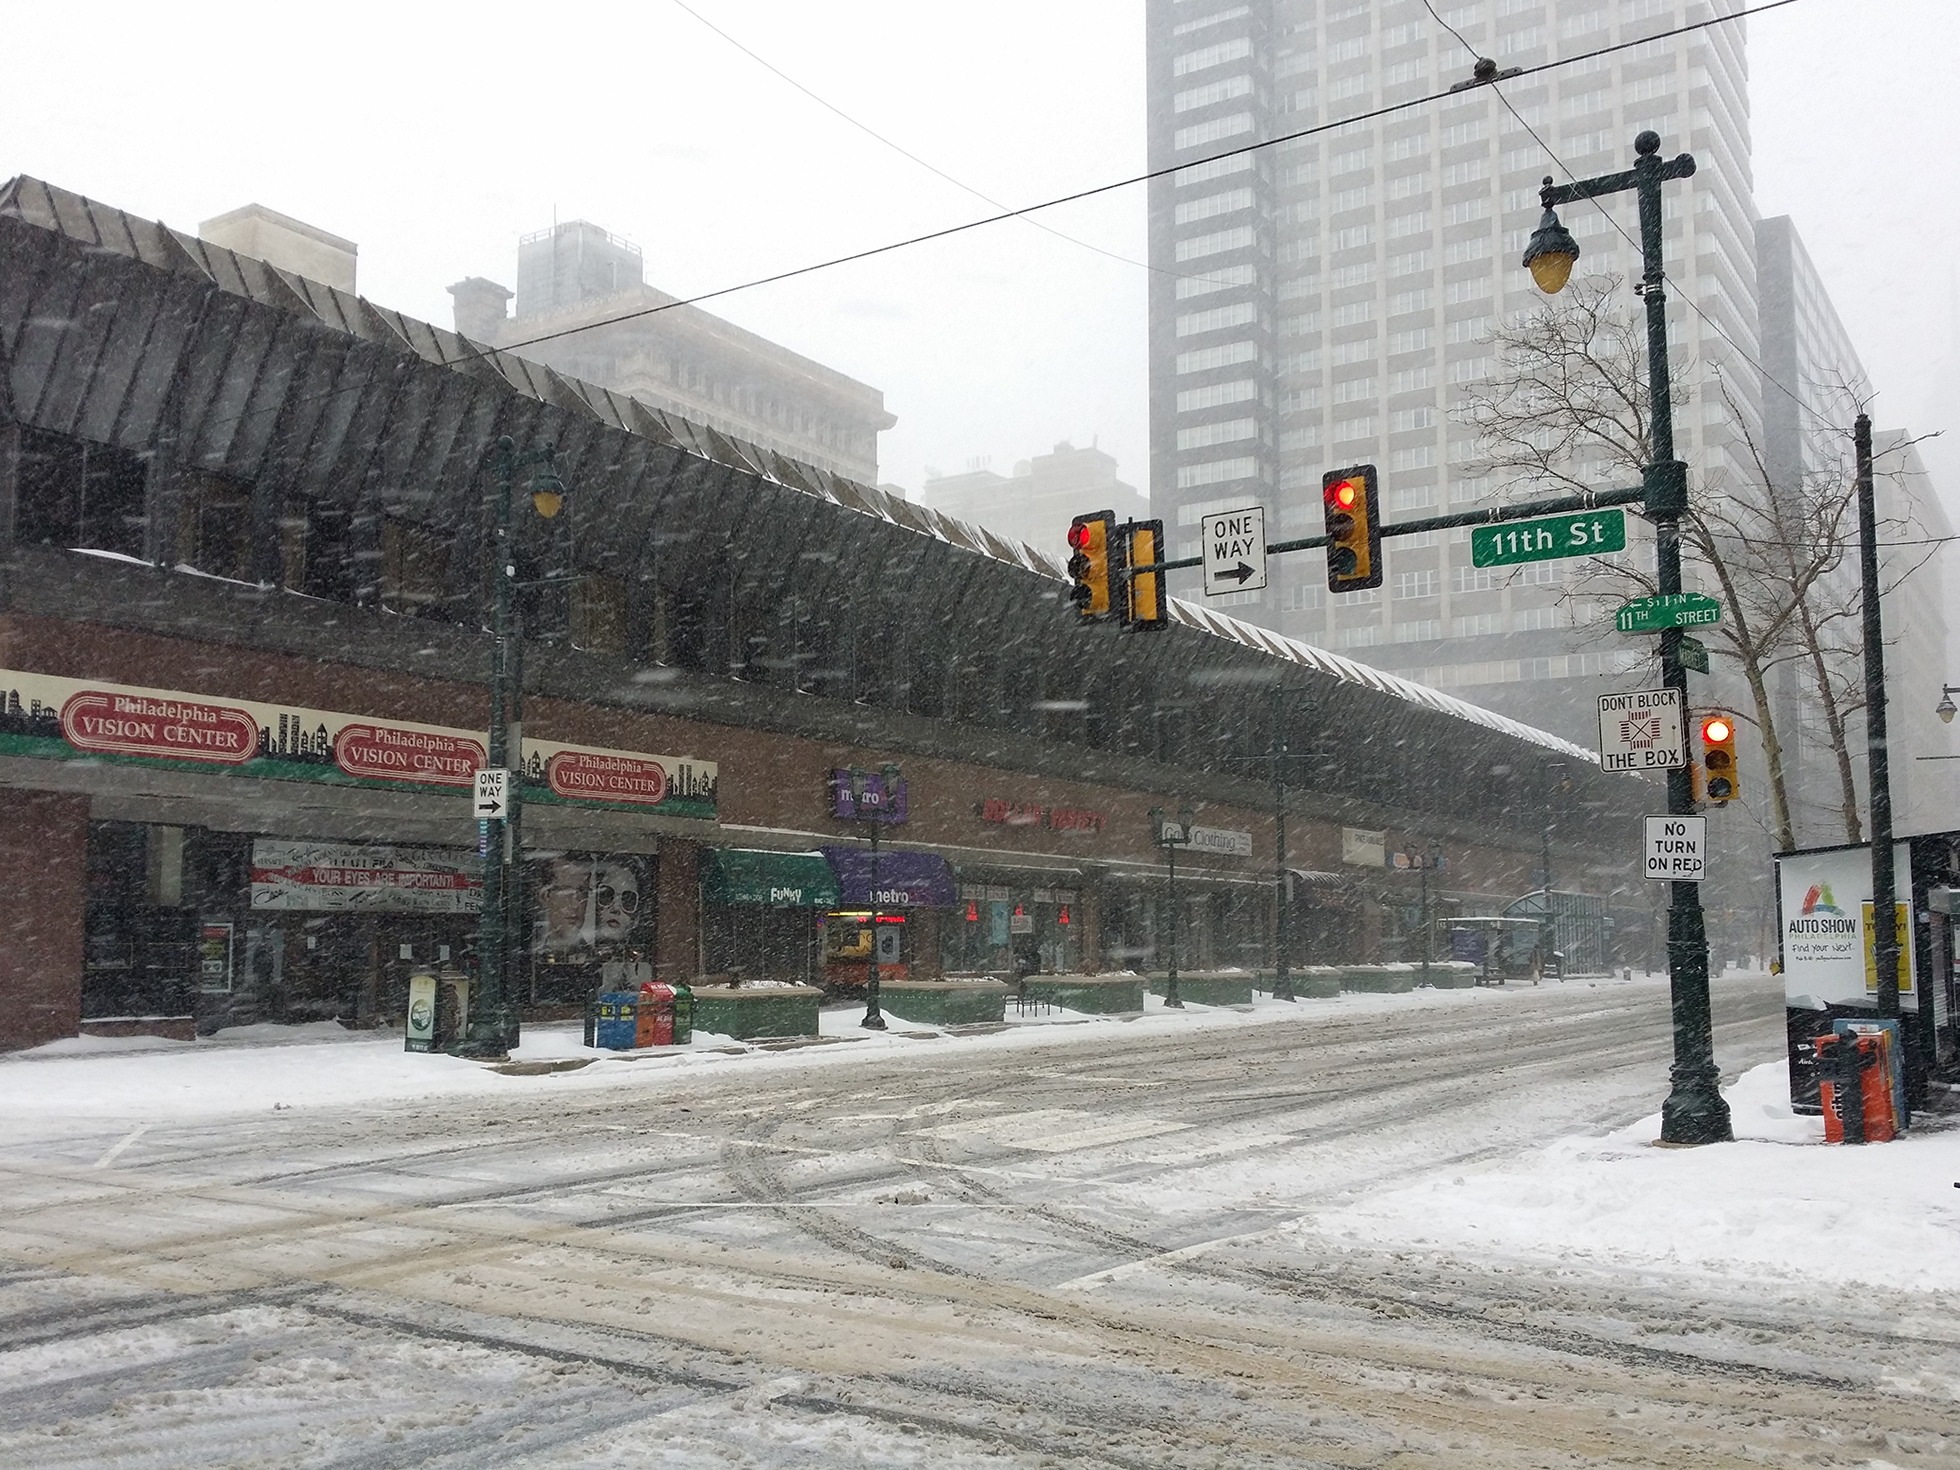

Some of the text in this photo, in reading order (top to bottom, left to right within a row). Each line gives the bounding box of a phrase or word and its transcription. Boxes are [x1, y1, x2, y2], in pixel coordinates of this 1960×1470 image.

[1214, 516, 1253, 538] ONE
[1492, 521, 1604, 555] 11th St
[1214, 537, 1255, 560] WAY
[1647, 598, 1654, 607] S
[1679, 595, 1687, 604] N
[1675, 608, 1718, 625] STREET
[1638, 691, 1677, 708] BLOCK
[114, 696, 217, 724] Philadelphia
[82, 716, 239, 748] VISION CENTER
[375, 729, 455, 753] Philadelphia
[351, 747, 472, 773] VISION CENTER
[579, 755, 642, 774] Philadelphia
[1606, 749, 1679, 769] THE BOX
[479, 773, 502, 785] ONE
[560, 771, 655, 792] VISION CENTER
[479, 786, 502, 797] WAY
[841, 788, 880, 804] mtro
[1664, 823, 1686, 837] NO
[1194, 830, 1236, 852] Clothing
[1655, 840, 1696, 854] TURN
[1648, 858, 1702, 871] ON RED
[312, 868, 341, 884] YOUR
[344, 871, 370, 886] EYES
[374, 872, 395, 886] ARE
[398, 872, 454, 888] IMPORTANT!
[1789, 919, 1856, 933] AUTO SHOW
[1792, 943, 1810, 953] Find
